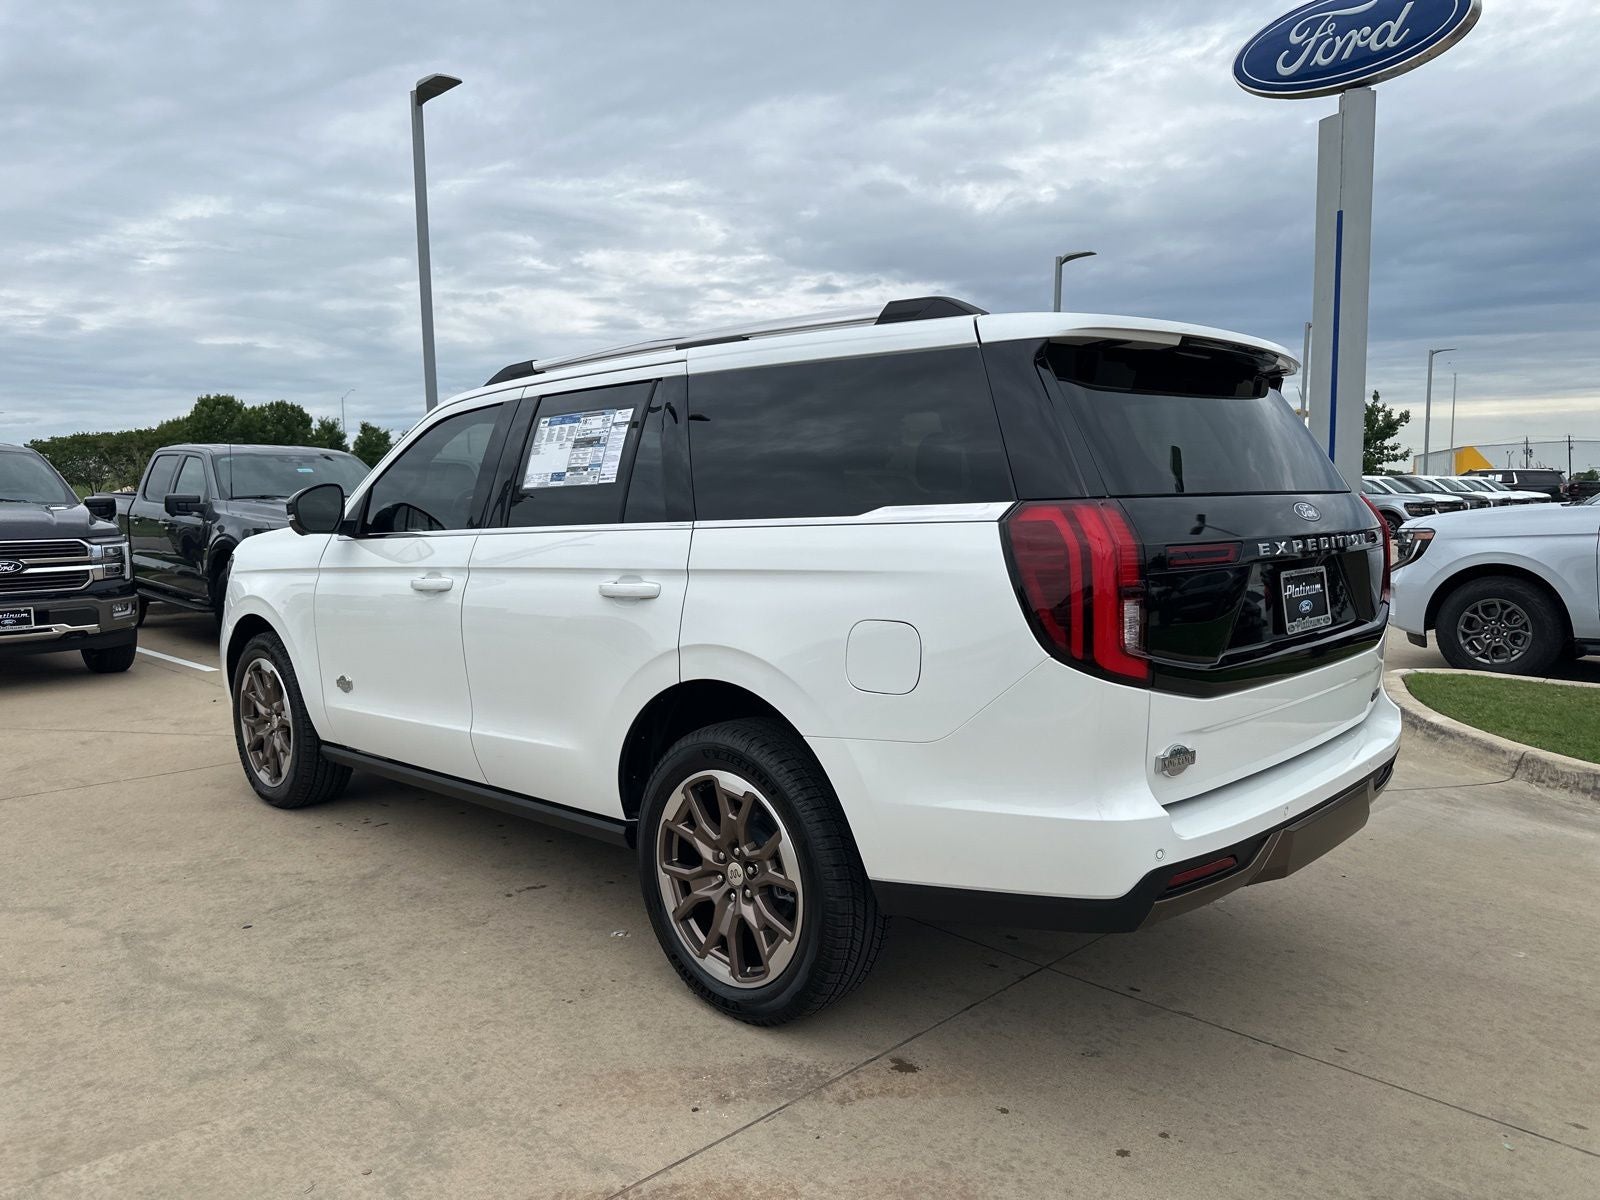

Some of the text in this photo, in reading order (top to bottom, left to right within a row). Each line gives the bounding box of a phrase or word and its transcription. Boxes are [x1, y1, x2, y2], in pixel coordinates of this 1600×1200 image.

[1276, 0, 1414, 76] Ford
[1298, 503, 1318, 517] Ford
[1257, 533, 1366, 556] EXPEDITION
[1284, 582, 1324, 599] Platinum
